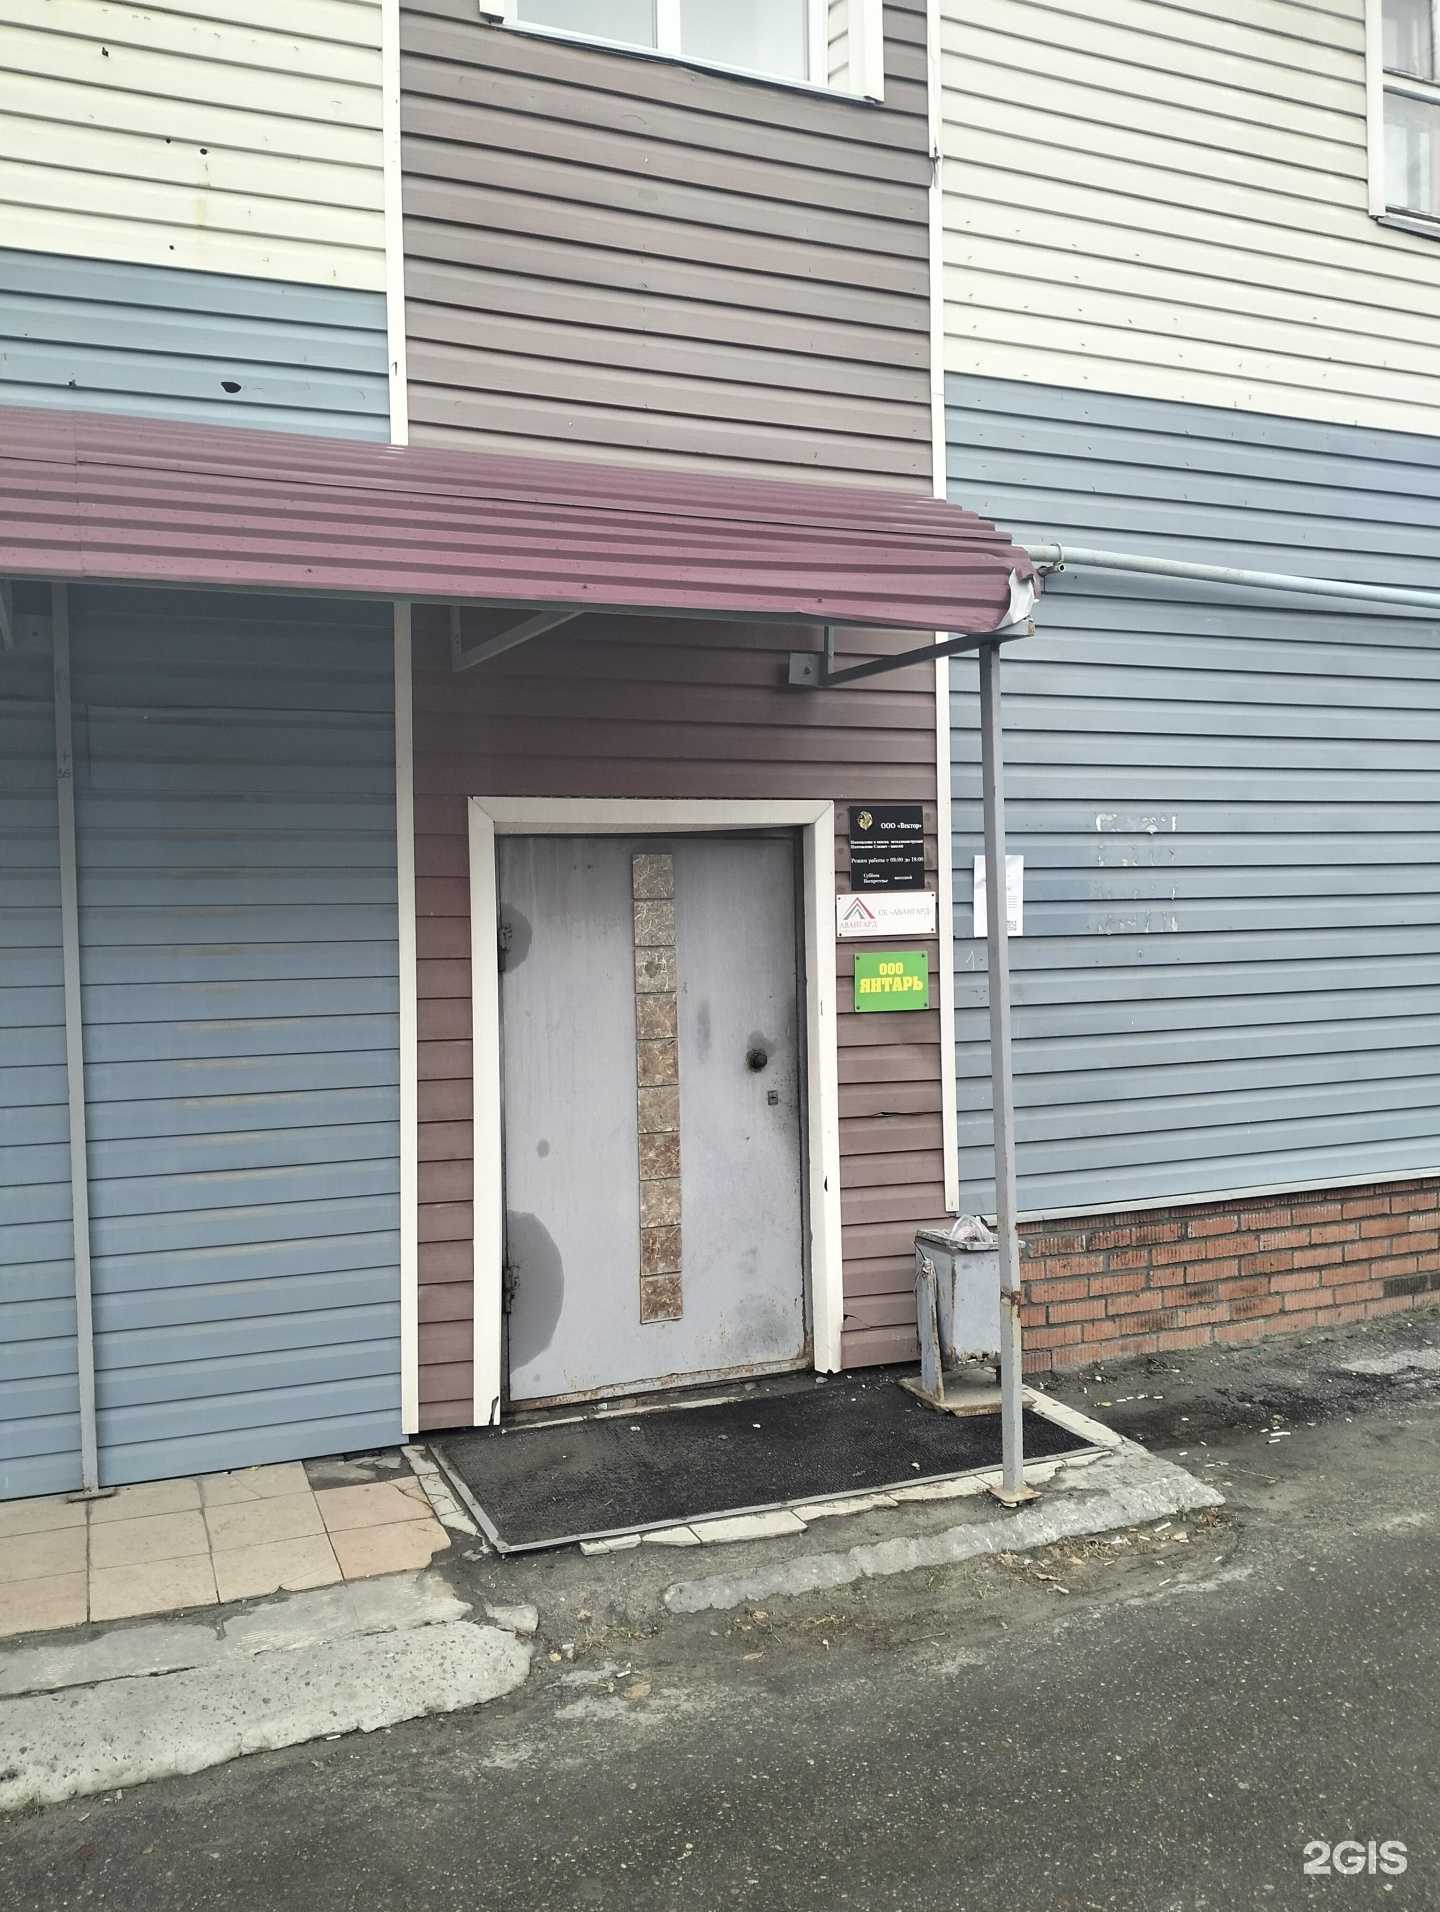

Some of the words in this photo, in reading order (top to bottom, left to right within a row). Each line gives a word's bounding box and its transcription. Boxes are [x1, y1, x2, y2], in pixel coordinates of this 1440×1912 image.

[897, 822, 922, 830] «Вектор»
[840, 920, 878, 929] АВАНГАРД
[879, 962, 903, 975] ООО
[860, 976, 923, 993] ЯНТАРЬ
